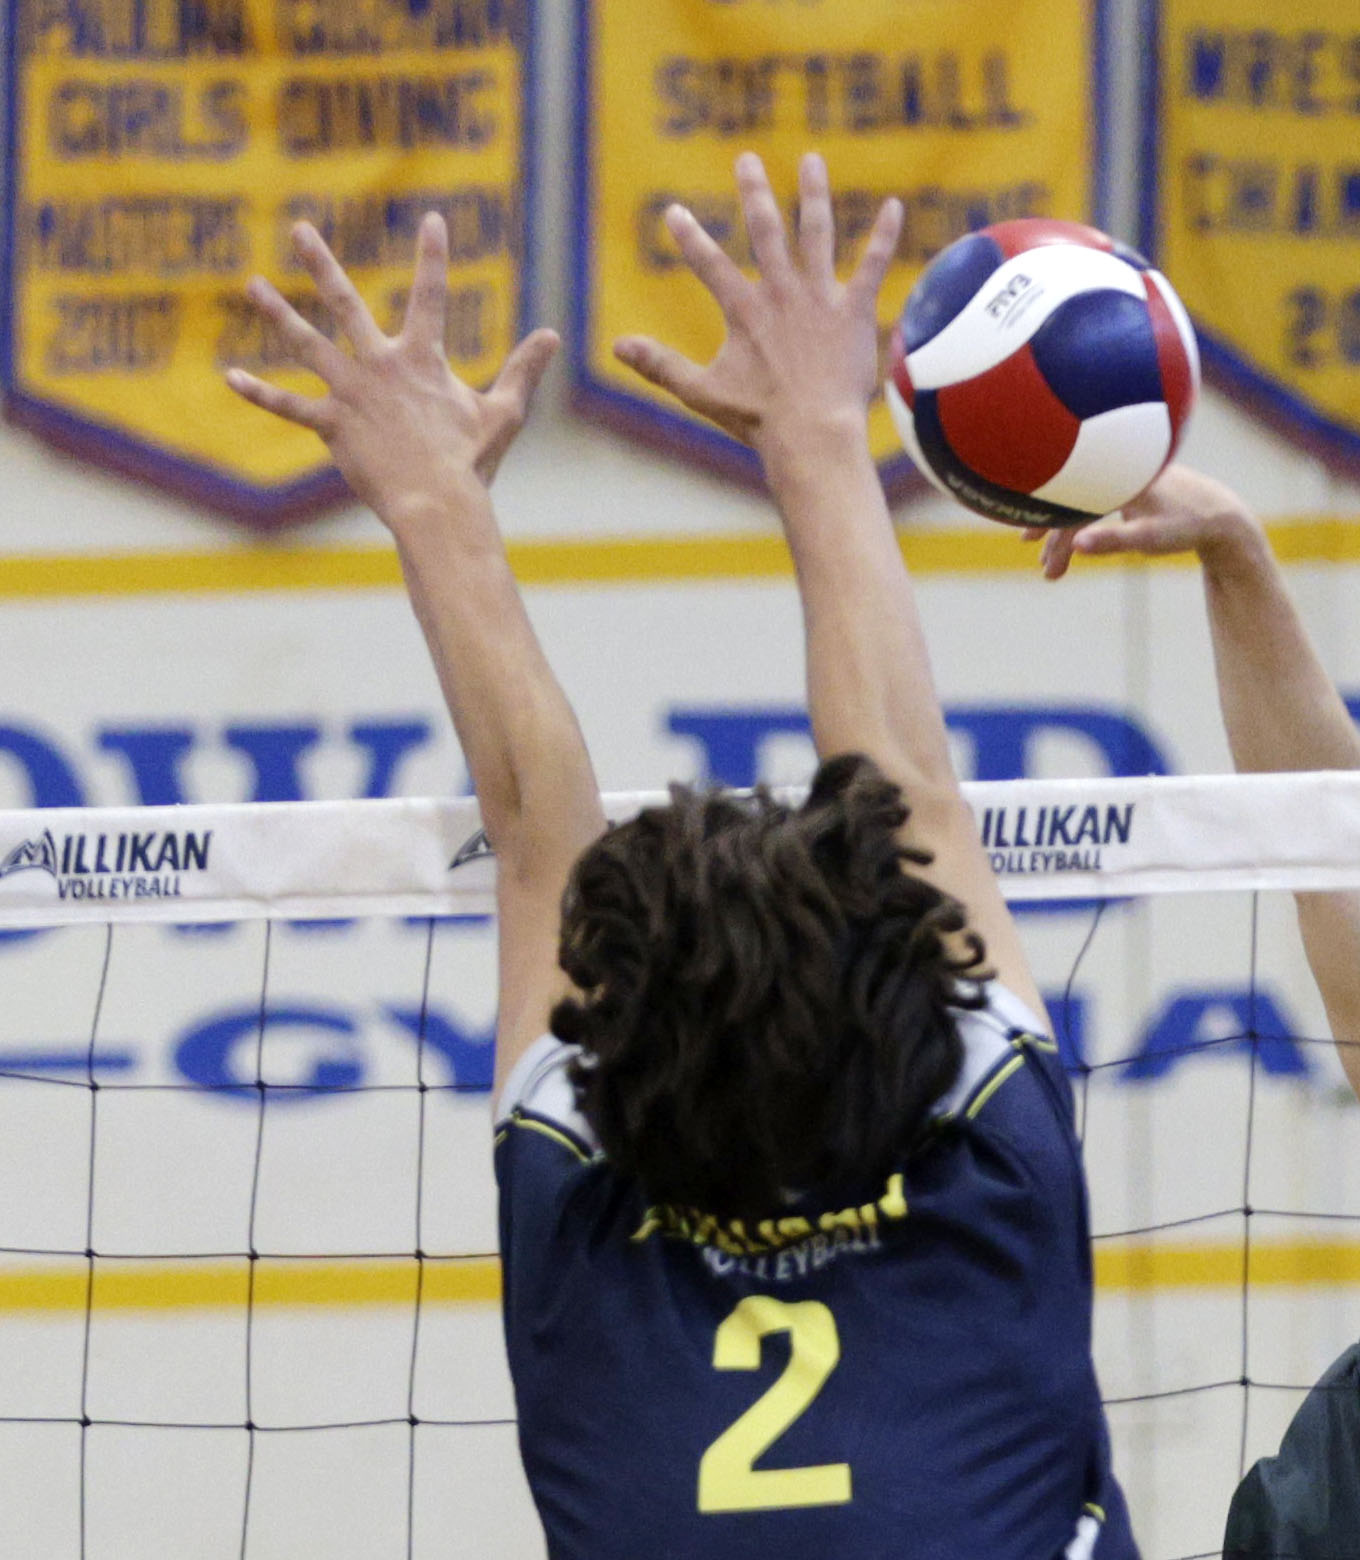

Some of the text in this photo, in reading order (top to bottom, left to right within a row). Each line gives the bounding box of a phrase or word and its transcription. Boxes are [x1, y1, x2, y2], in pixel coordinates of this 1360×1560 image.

[48, 78, 248, 162] GIRLS
[652, 50, 1036, 138] SOFTBALL
[980, 802, 1136, 847] ILLIKAN
[57, 876, 183, 901] VOLLEYBALL
[696, 1295, 853, 1515] 2
